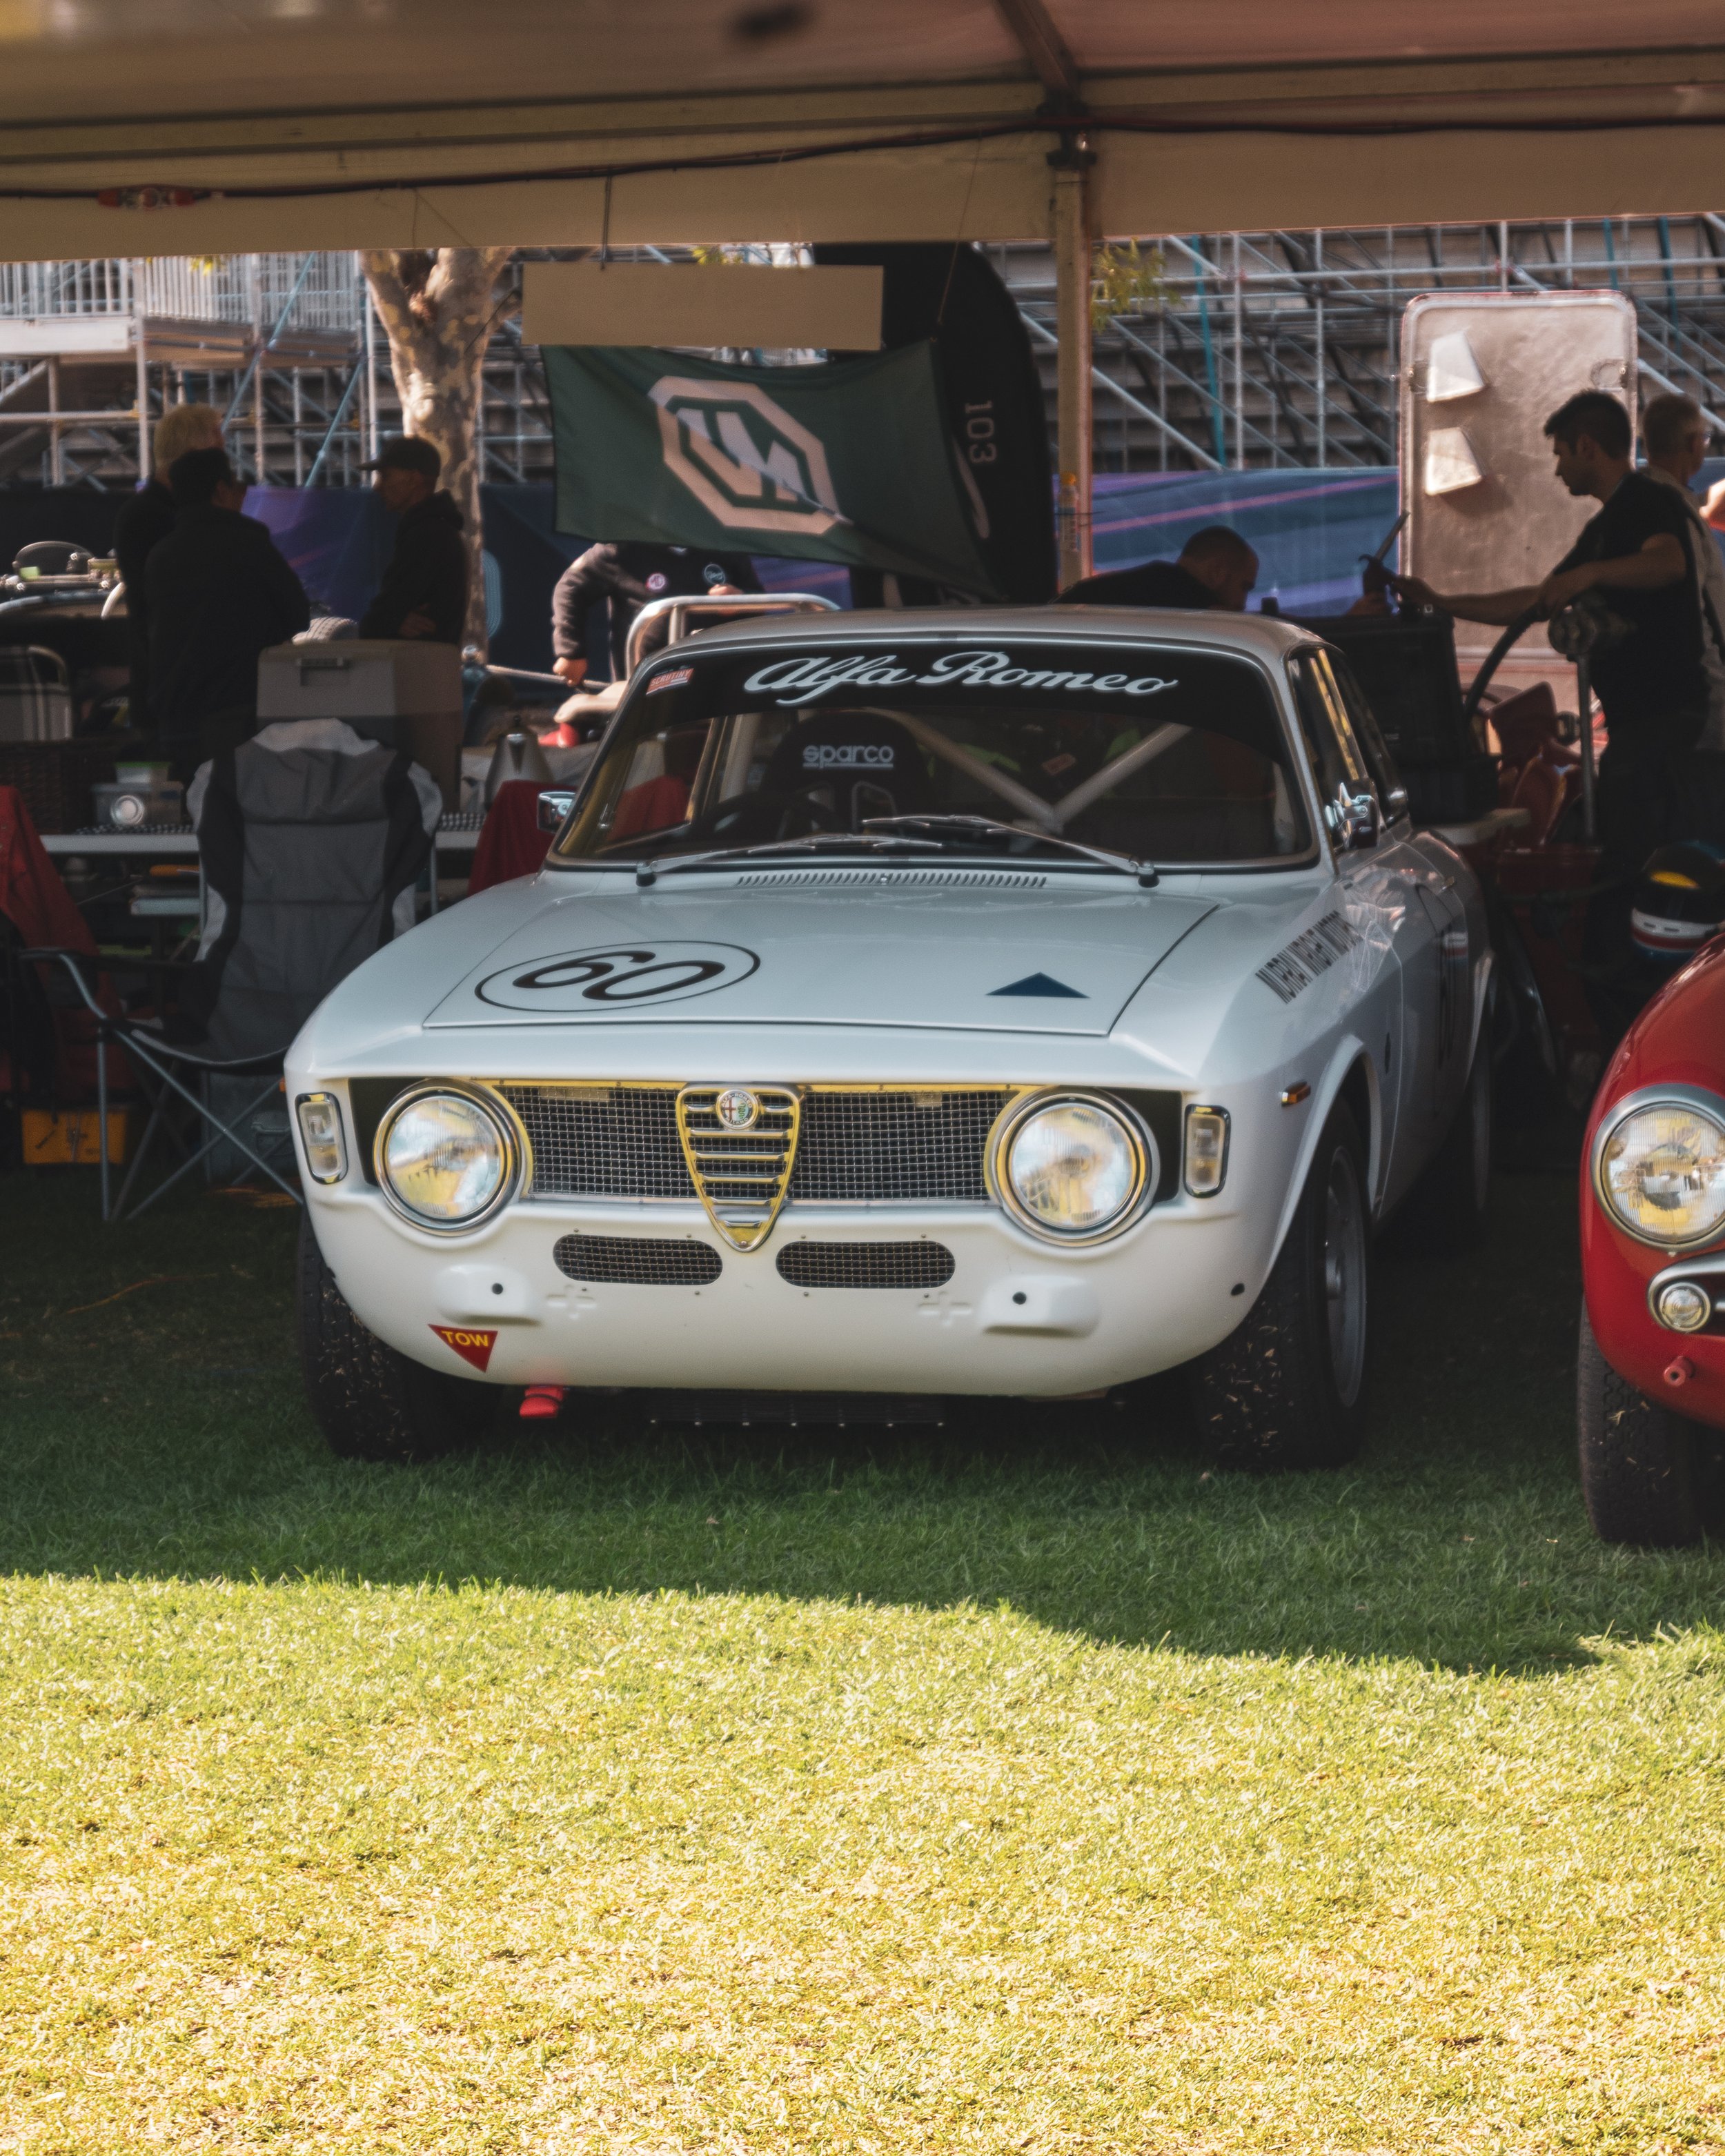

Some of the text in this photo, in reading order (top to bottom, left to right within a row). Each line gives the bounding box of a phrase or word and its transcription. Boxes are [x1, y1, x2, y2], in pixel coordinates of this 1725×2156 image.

[965, 400, 997, 464] 103
[651, 669, 691, 685] SCRUTINY
[744, 651, 1179, 704] Alfa Romeo
[803, 745, 894, 769] sparco
[512, 951, 726, 1000] 60
[1254, 949, 1313, 1005] MURRAY
[442, 1330, 489, 1347] TOW
